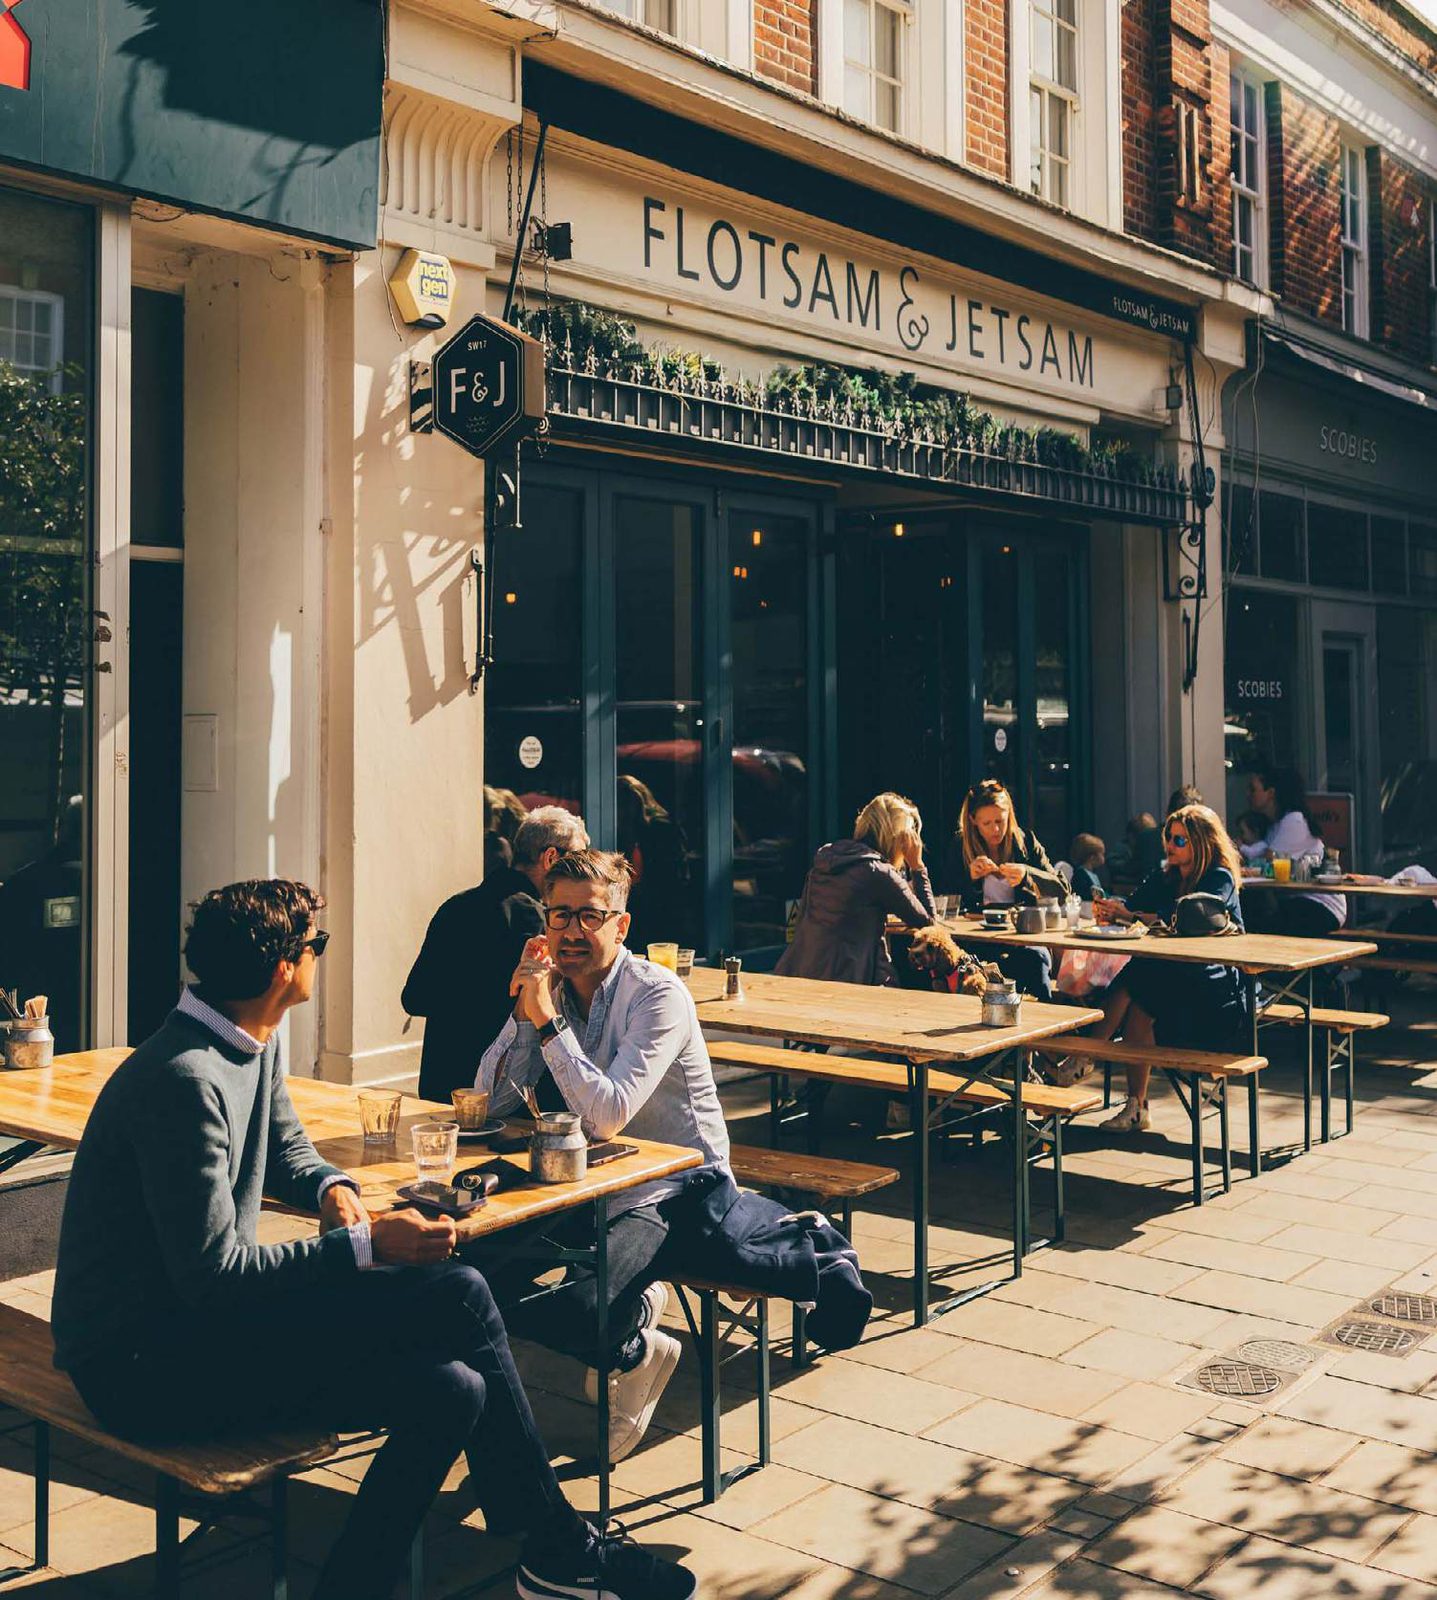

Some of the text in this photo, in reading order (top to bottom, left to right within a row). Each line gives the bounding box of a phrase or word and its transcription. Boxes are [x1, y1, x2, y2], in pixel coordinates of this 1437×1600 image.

[419, 261, 448, 279] next
[421, 278, 447, 296] gen
[643, 196, 1093, 388] FLOTSAM & JETSAM
[467, 340, 487, 351] SW17
[1320, 424, 1377, 463] SCOBIES
[1237, 680, 1282, 698] SCOBIES
